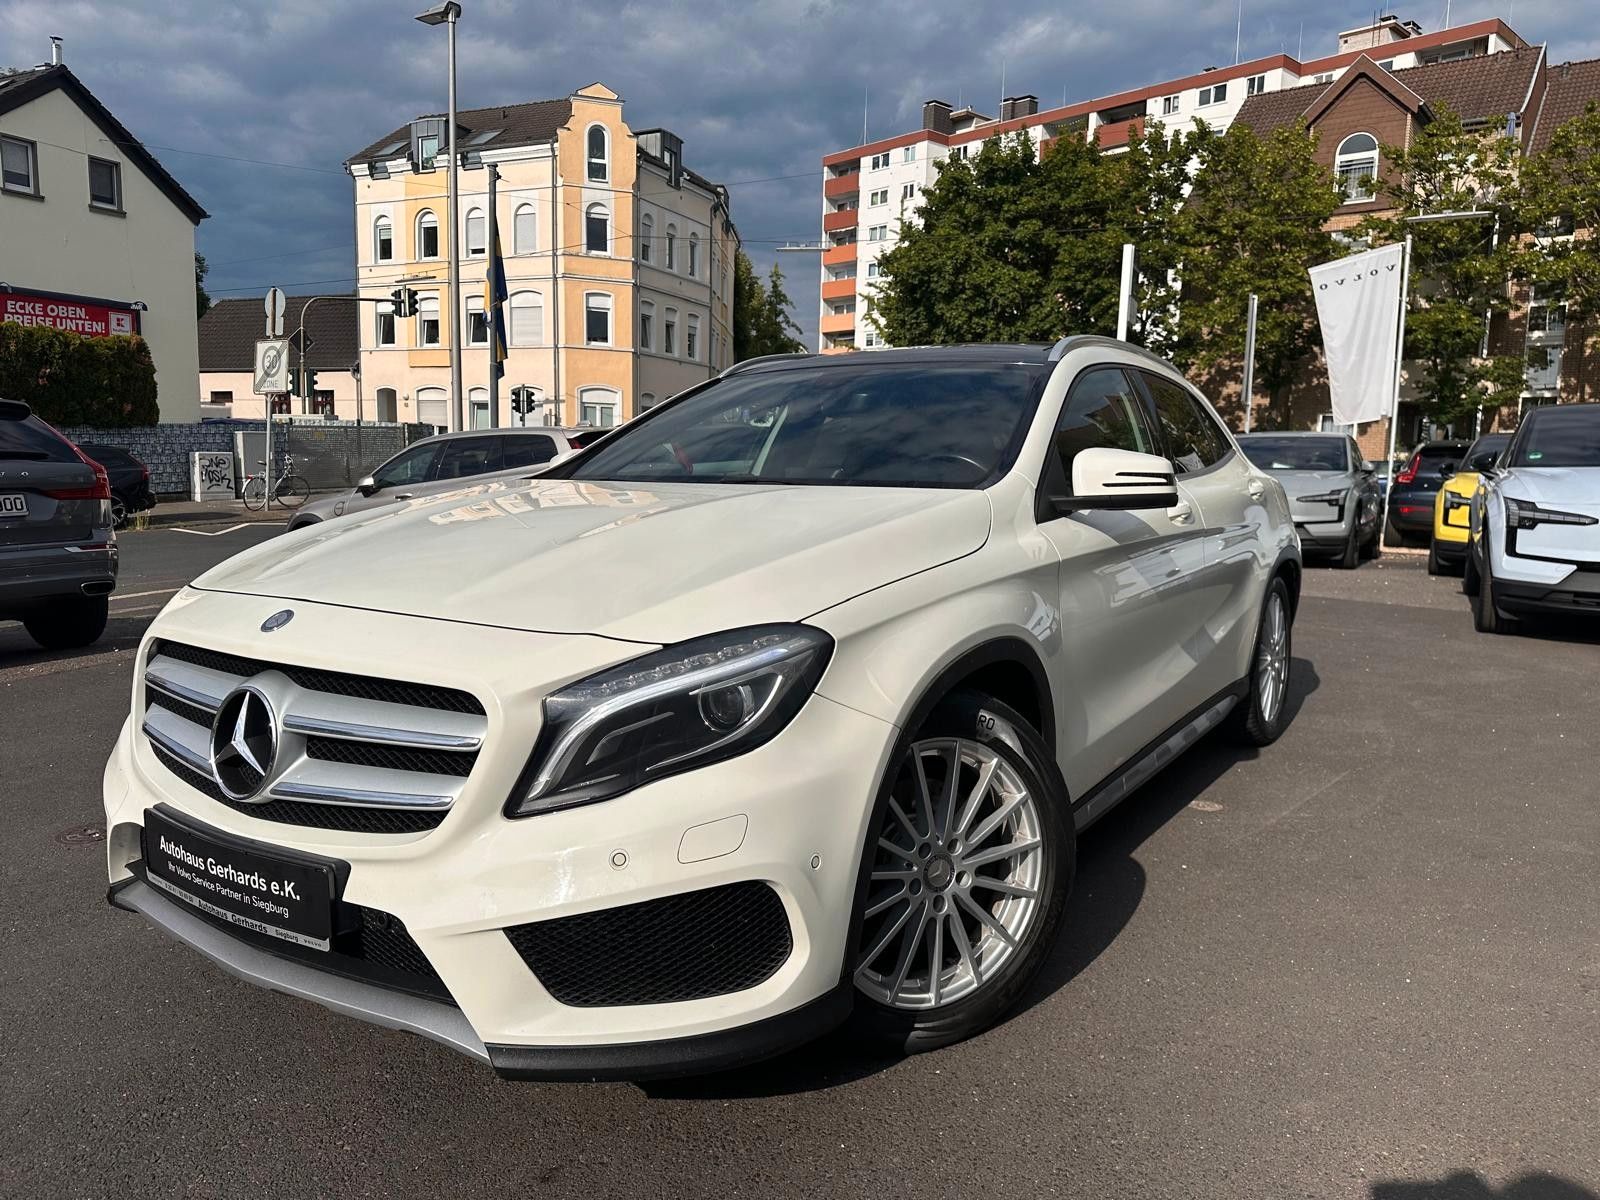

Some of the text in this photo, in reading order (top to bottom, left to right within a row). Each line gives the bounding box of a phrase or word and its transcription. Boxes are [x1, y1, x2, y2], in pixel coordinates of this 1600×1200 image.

[3, 313, 105, 334] PREISE UNTEN!
[6, 300, 89, 320] ECKE OBEN.
[265, 354, 278, 369] 30
[160, 835, 205, 871] Autohaus
[206, 857, 268, 892] Gerhards
[270, 880, 301, 901] e.K.
[175, 864, 192, 881] Volvo
[191, 872, 215, 892] Service
[215, 882, 242, 902] Partner
[242, 892, 251, 905] in
[251, 895, 289, 919] Siegburg
[198, 898, 229, 920] Autohaus
[231, 913, 268, 934] Gerhards
[274, 928, 299, 943] Siegburg
